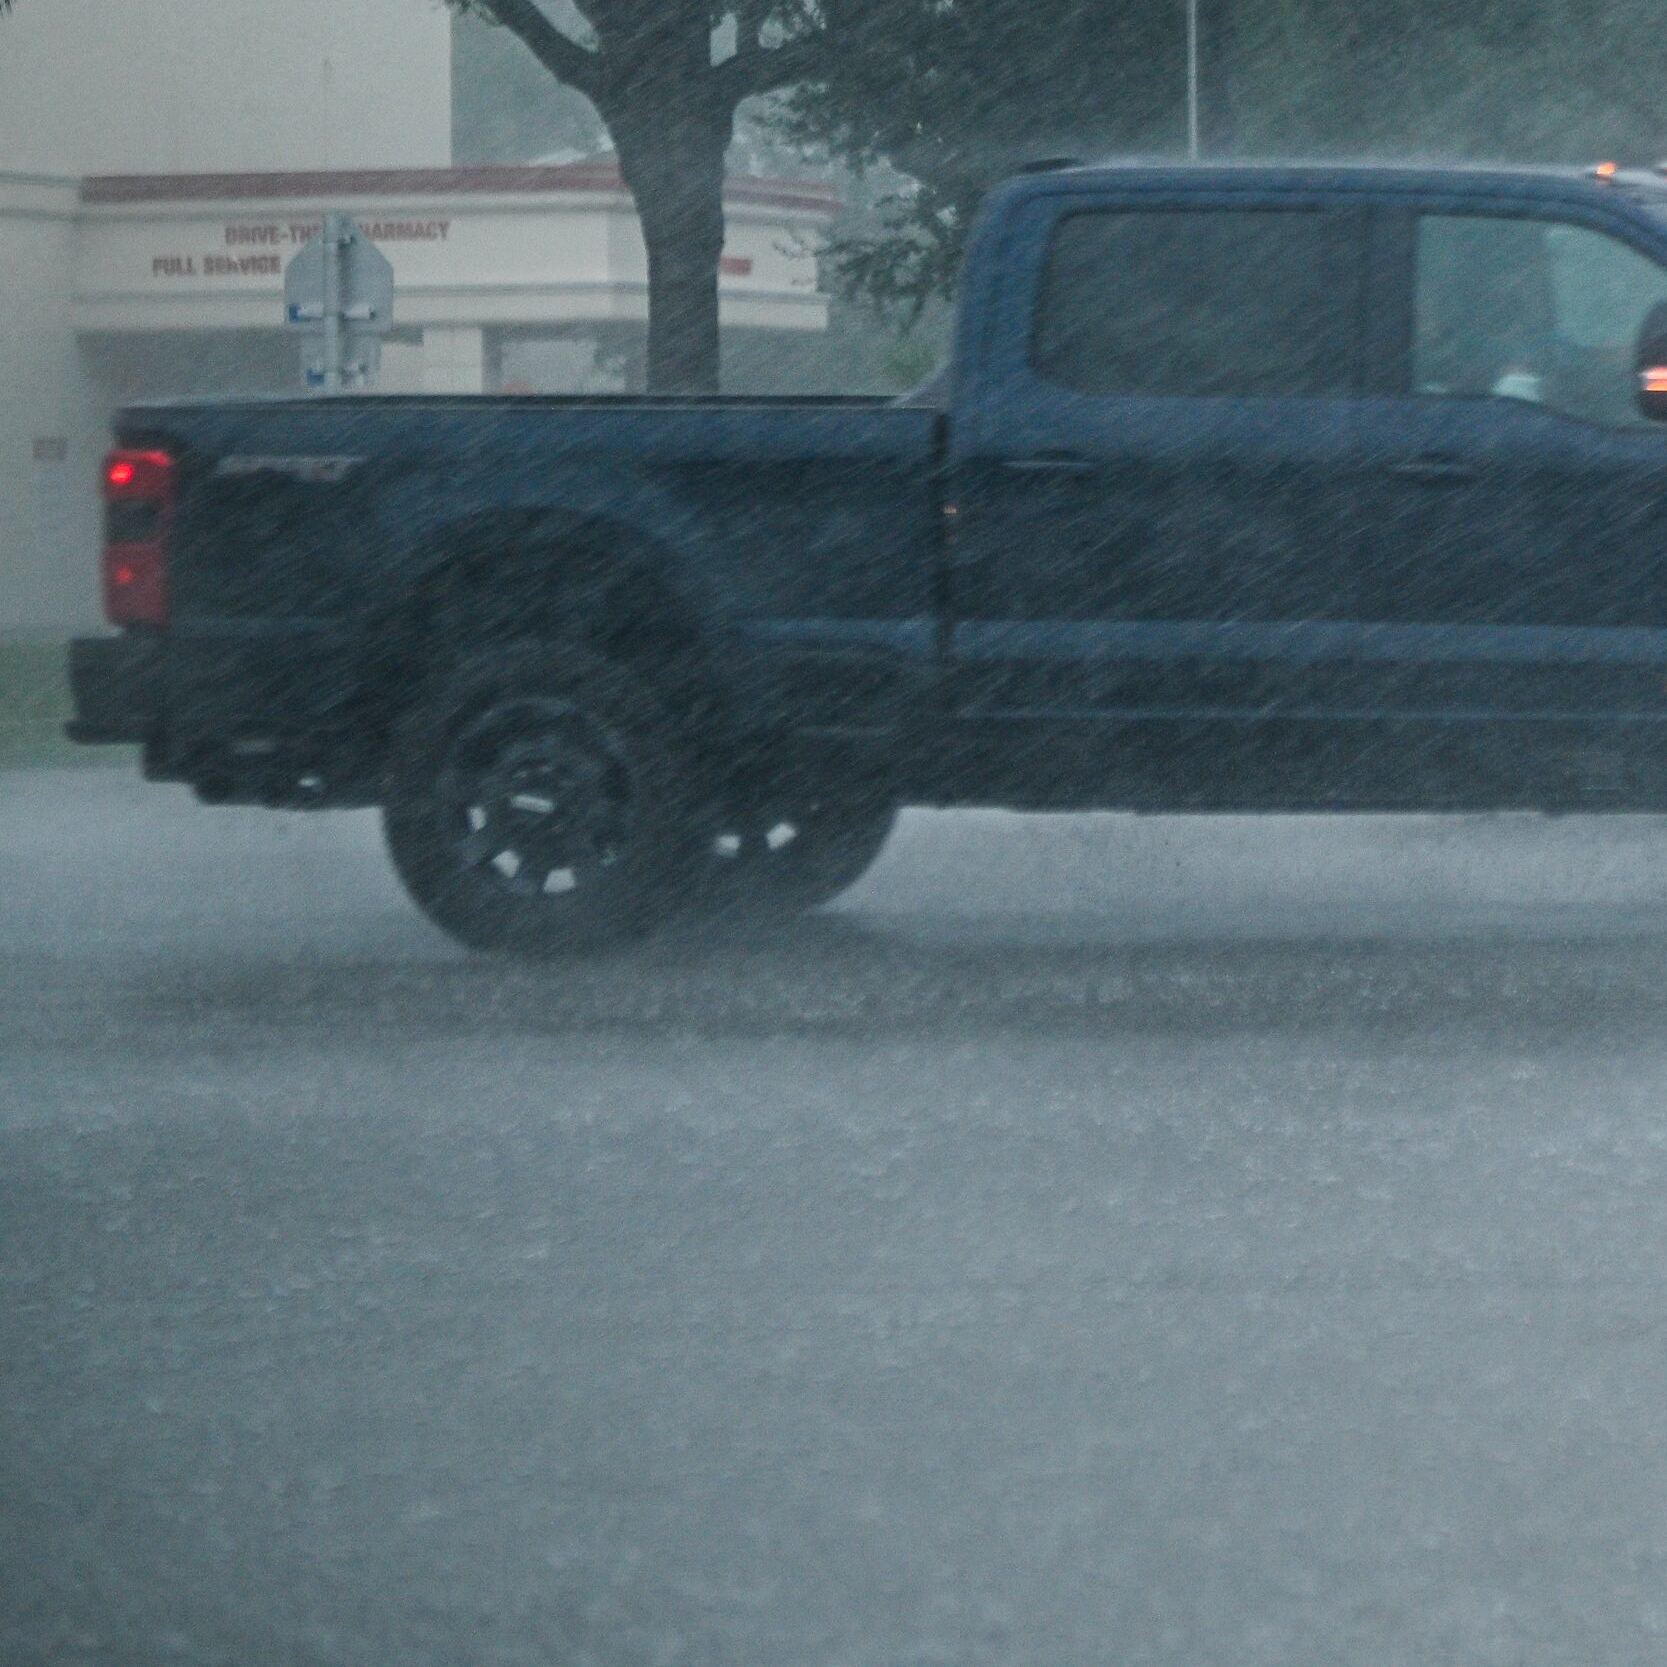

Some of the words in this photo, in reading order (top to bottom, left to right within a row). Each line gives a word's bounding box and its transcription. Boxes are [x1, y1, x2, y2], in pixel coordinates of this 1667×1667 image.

[358, 220, 449, 240] HARMACY
[152, 256, 197, 277] FULL
[203, 254, 281, 274] SERVICE
